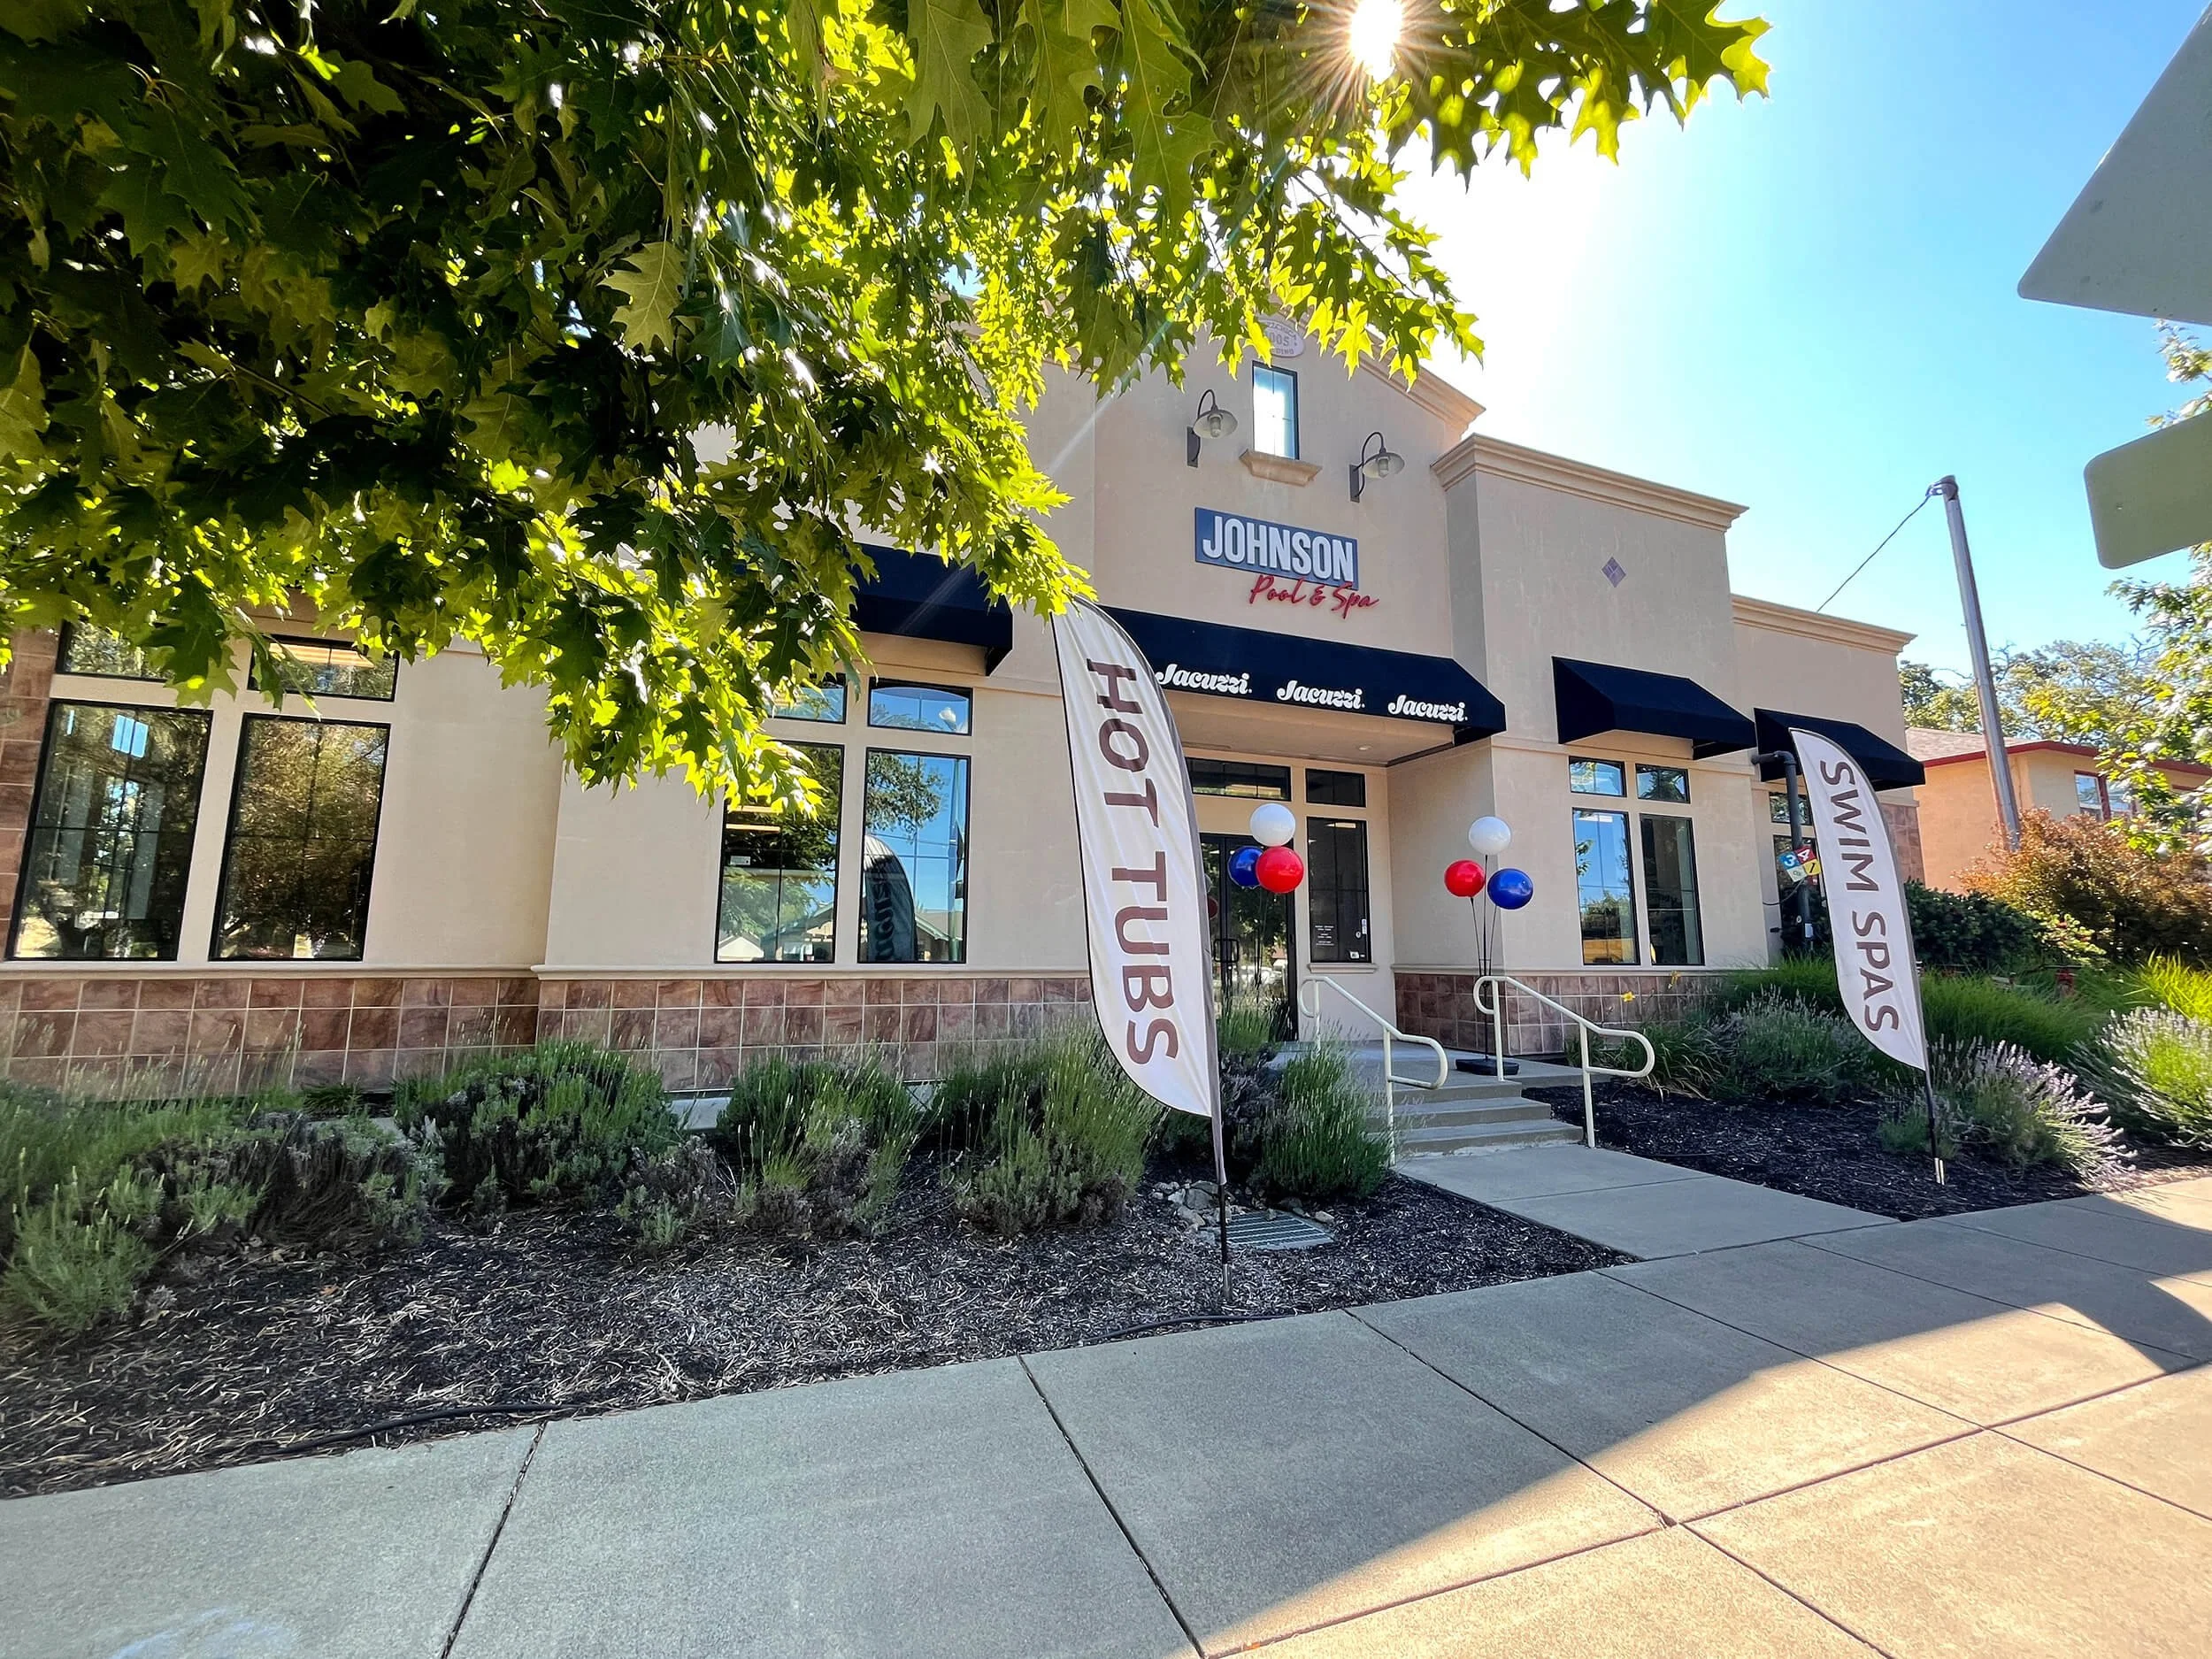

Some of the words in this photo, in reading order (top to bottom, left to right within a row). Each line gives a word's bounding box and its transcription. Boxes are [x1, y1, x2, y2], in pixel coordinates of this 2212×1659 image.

[1202, 516, 1355, 582] JOHNSON
[1248, 574, 1307, 604] Pool
[1309, 585, 1326, 606] &
[1331, 580, 1380, 619] Spa
[1087, 657, 1159, 828] HOT
[1784, 854, 1797, 867] 3
[1797, 849, 1810, 862] 4
[1820, 759, 1879, 892] SWIM
[1852, 910, 1900, 1033] SPAS
[1111, 850, 1179, 1064] TUBS
